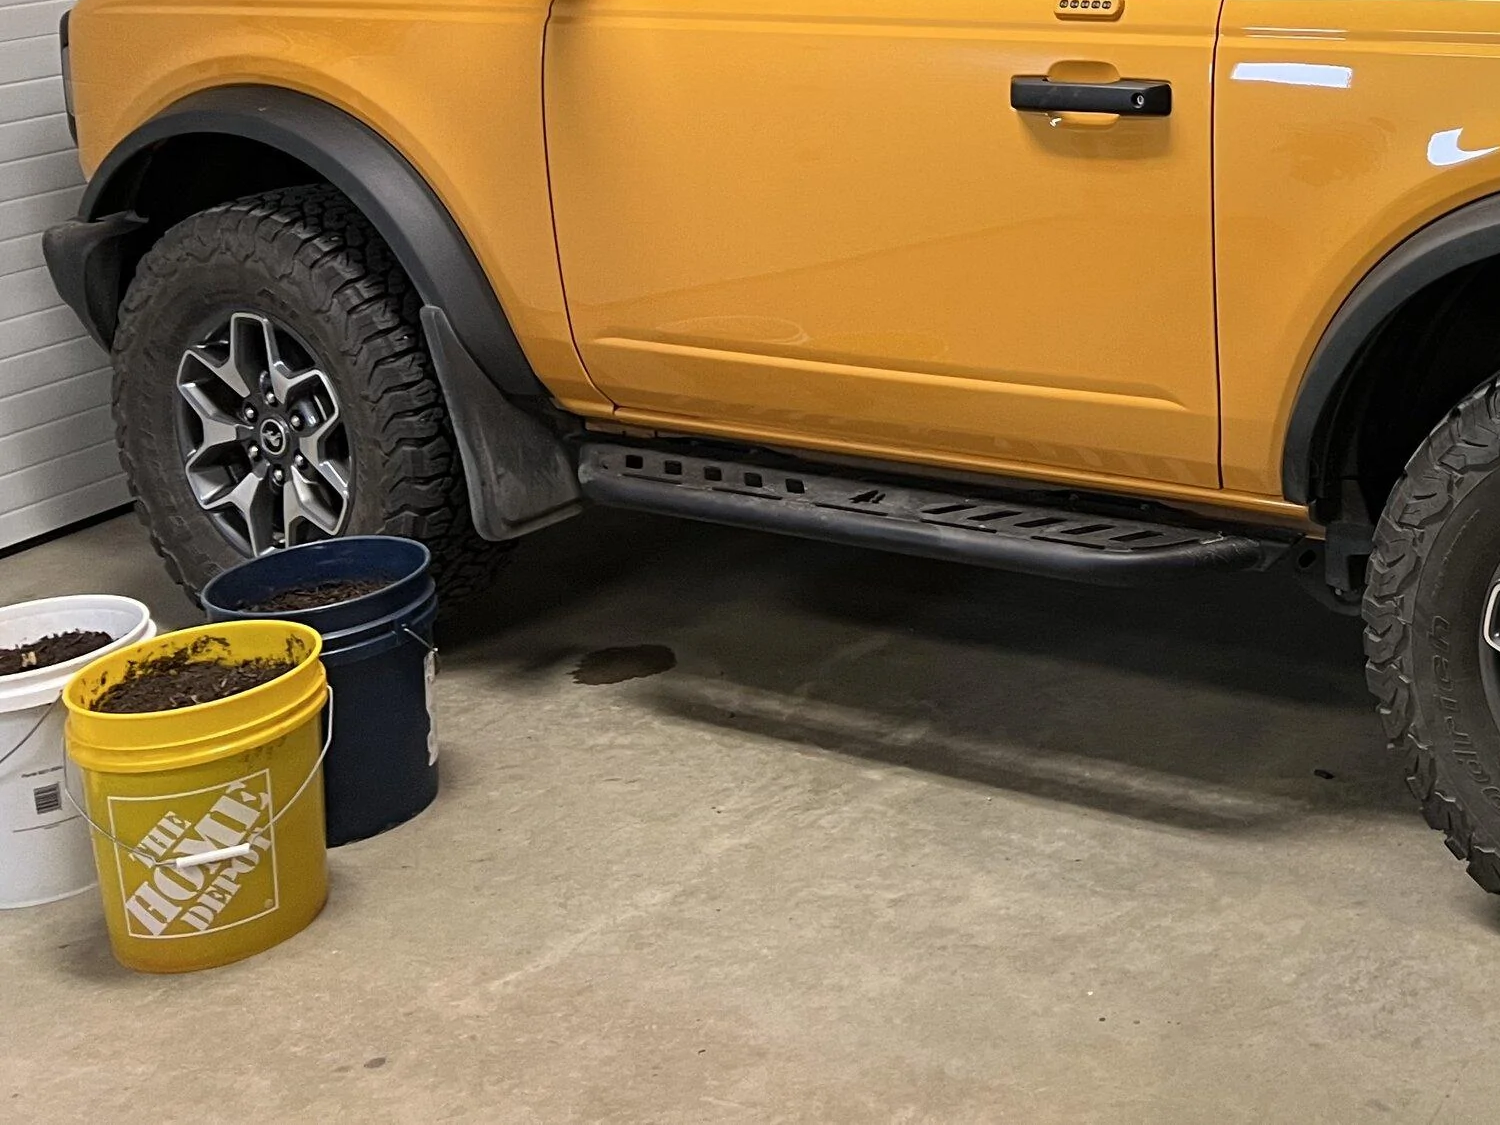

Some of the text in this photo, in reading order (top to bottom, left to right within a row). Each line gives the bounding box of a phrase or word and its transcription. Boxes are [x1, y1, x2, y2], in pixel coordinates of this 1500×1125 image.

[125, 781, 270, 936] HOME
[129, 811, 191, 868] THE
[180, 826, 272, 931] DEPOT
